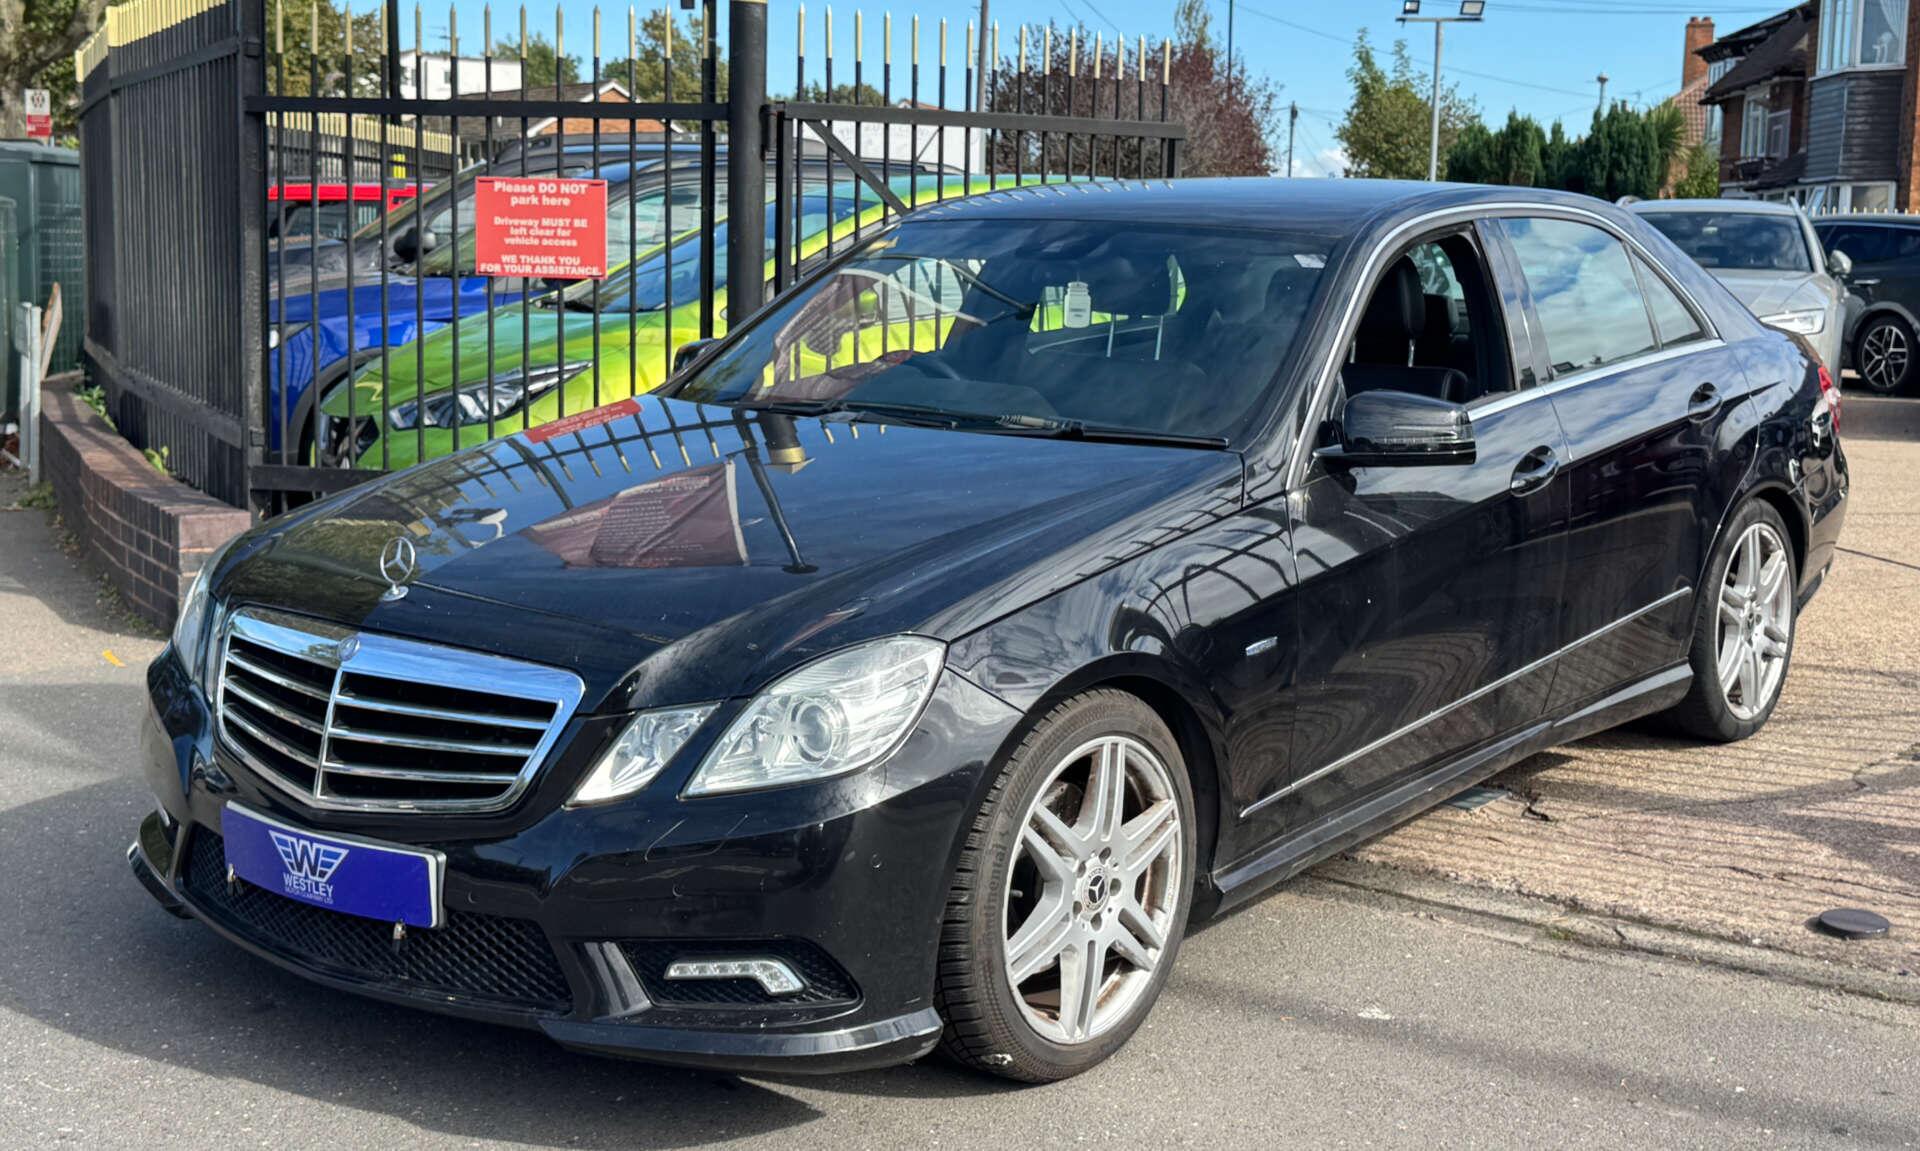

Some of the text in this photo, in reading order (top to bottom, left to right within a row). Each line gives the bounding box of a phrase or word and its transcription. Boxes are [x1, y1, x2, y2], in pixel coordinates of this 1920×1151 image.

[493, 181, 588, 195] Please DO NOT
[510, 195, 571, 207] park here
[493, 216, 588, 228] Driveway MUST BE
[510, 227, 572, 237] left clear for
[504, 237, 578, 247] vehicle access
[501, 255, 581, 266] WE THANK YOU
[480, 263, 501, 273] FOR
[503, 264, 533, 274] YOUR
[283, 872, 333, 897] WESTLEY
